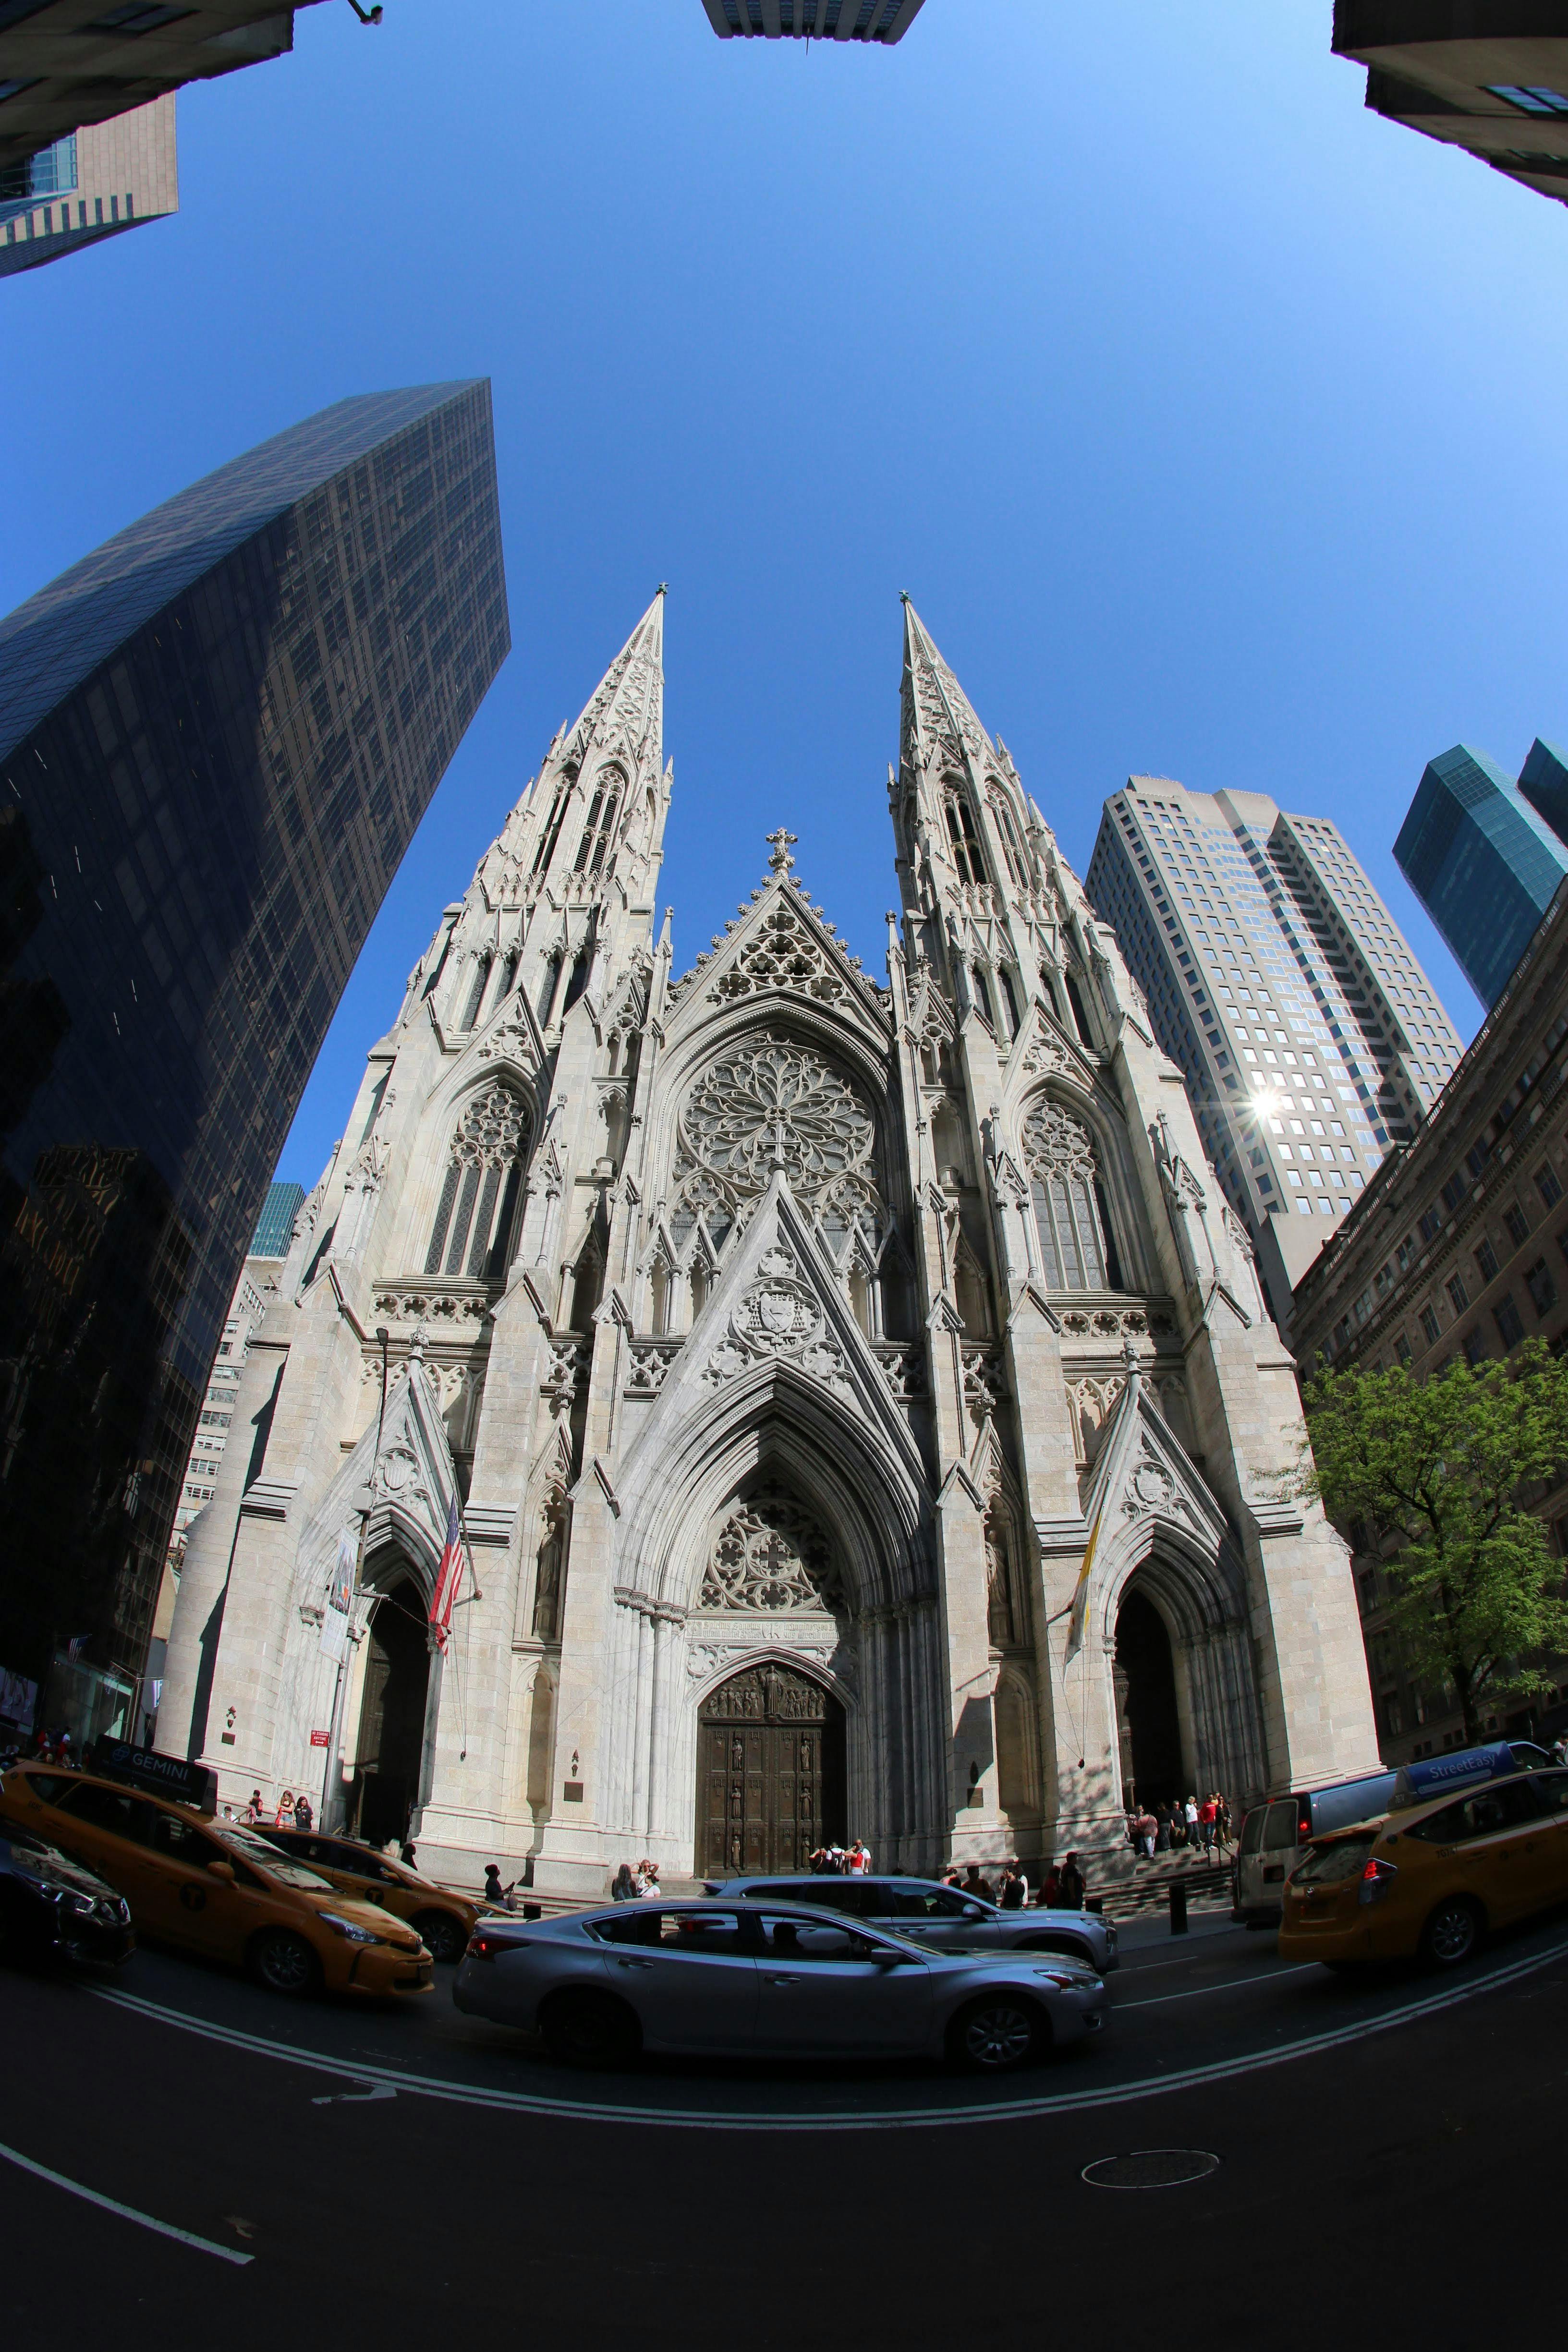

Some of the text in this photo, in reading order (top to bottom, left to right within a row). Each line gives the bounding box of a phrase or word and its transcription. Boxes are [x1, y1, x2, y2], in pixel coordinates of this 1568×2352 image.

[133, 1753, 189, 1782] GEMINI
[1429, 1754, 1496, 1779] StreetEasy
[370, 1891, 380, 1903] T
